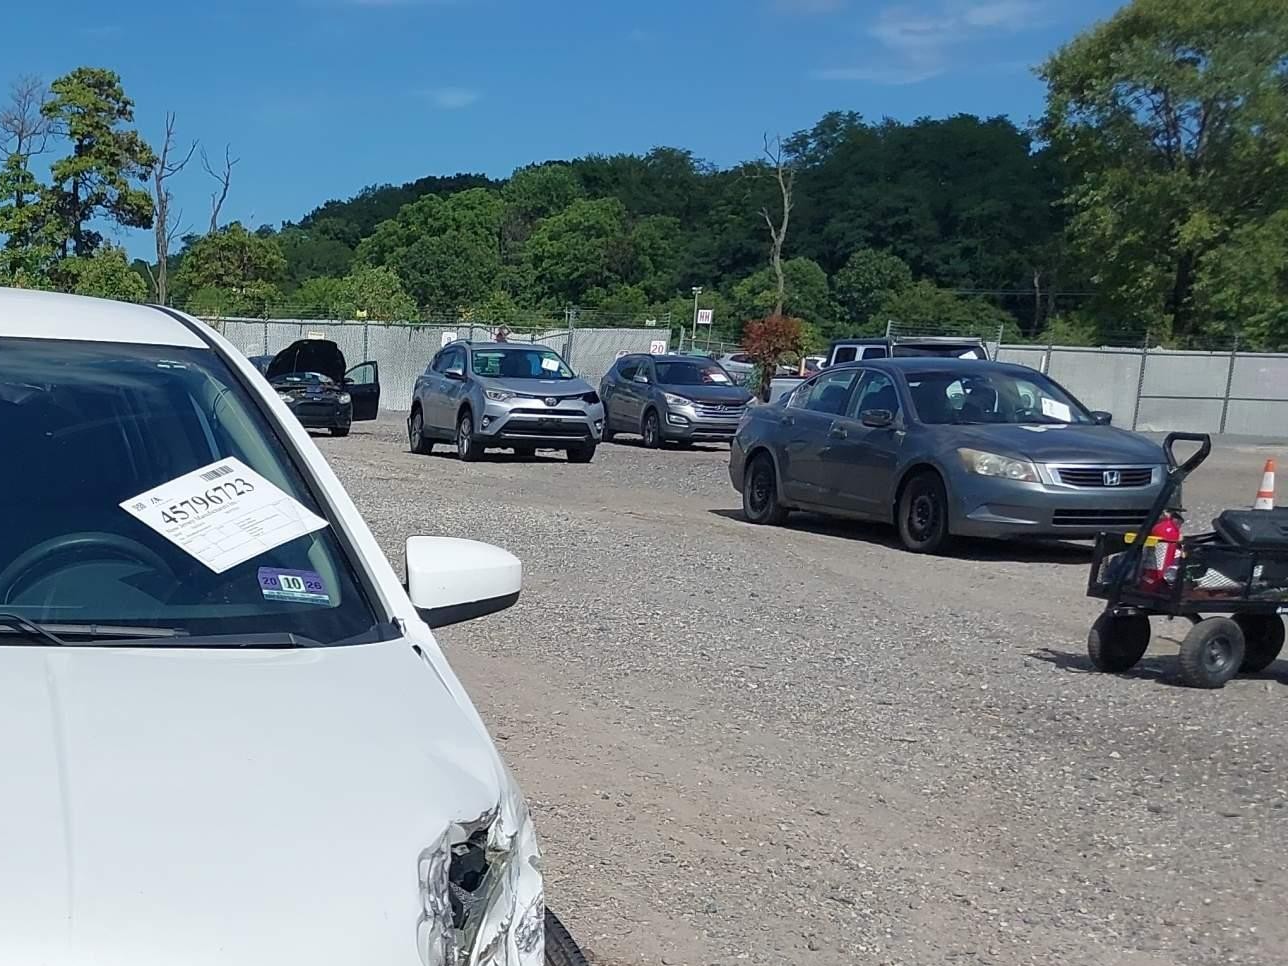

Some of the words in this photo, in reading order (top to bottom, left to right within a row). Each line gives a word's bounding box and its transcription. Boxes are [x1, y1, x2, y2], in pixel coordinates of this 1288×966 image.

[652, 345, 664, 354] 20
[162, 478, 254, 523] 45796723
[262, 577, 277, 585] 20
[283, 577, 302, 589] 10
[306, 581, 322, 590] 26
